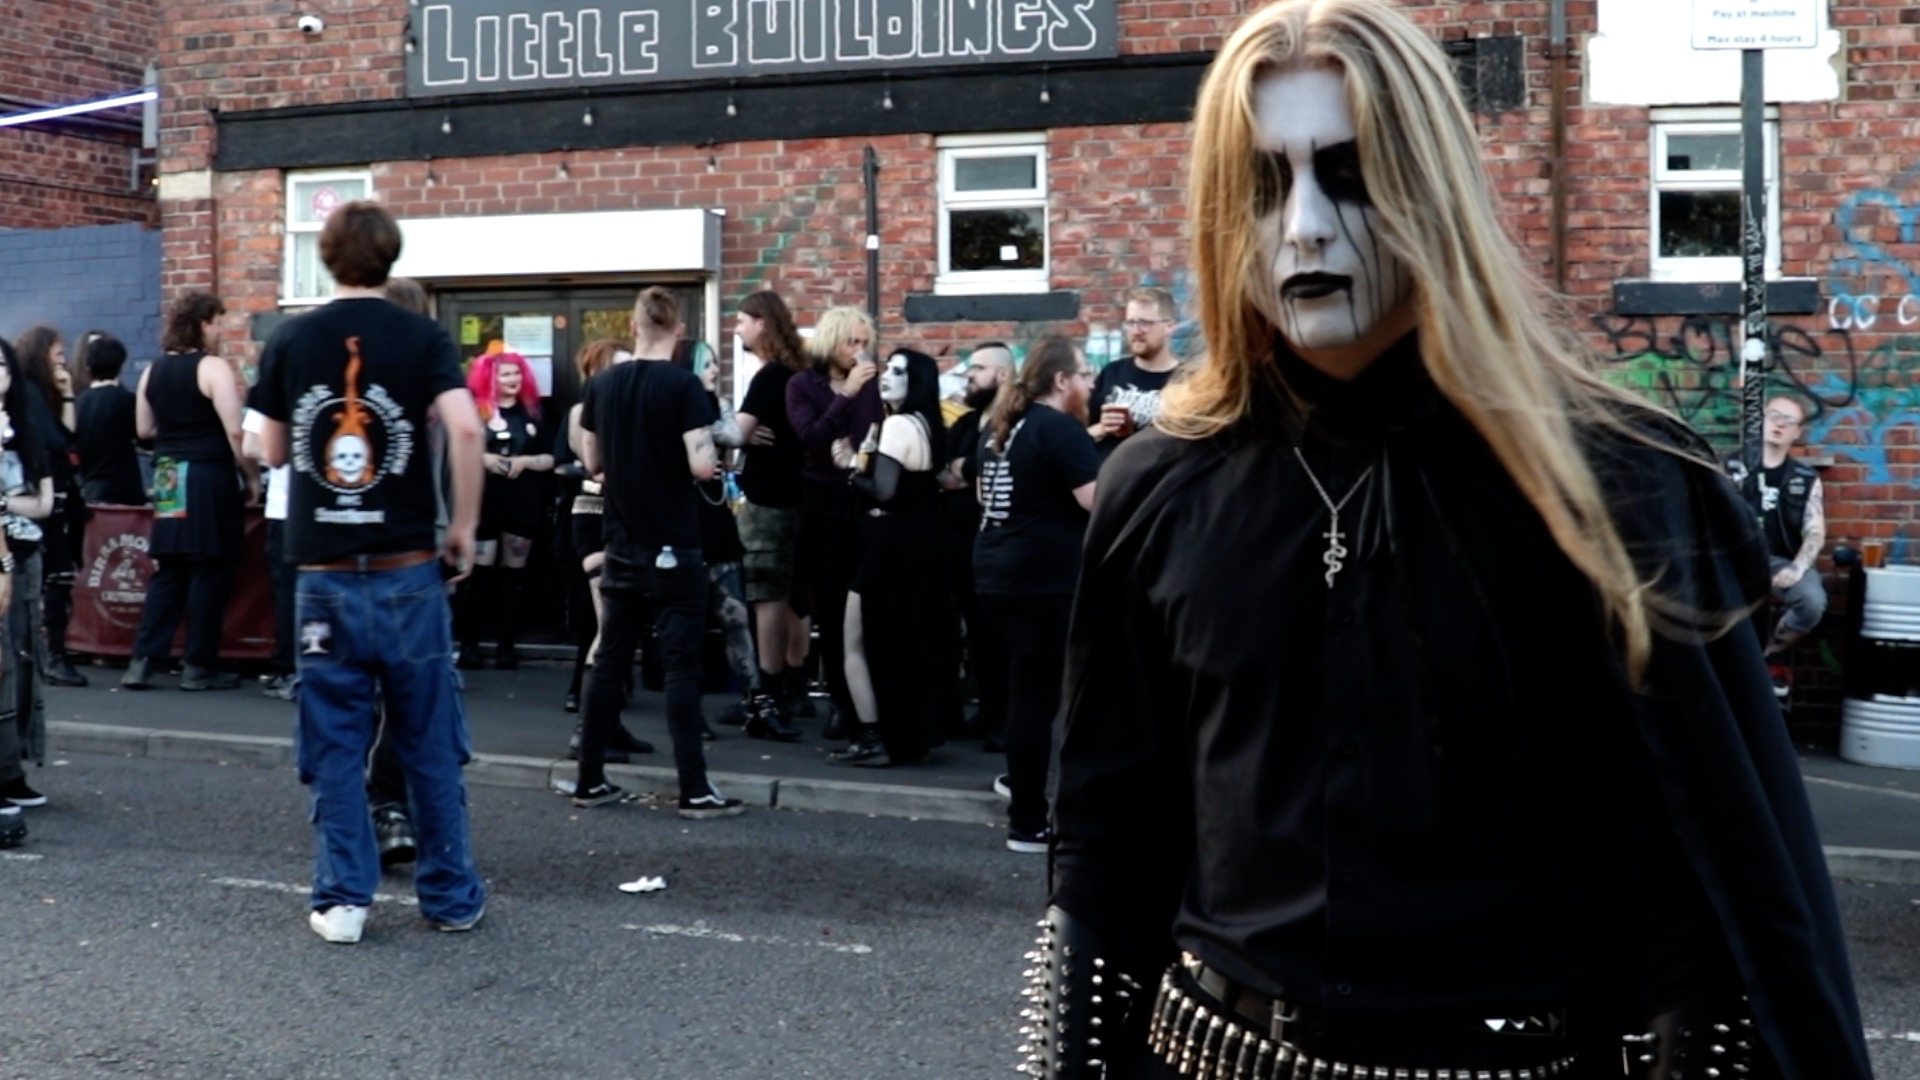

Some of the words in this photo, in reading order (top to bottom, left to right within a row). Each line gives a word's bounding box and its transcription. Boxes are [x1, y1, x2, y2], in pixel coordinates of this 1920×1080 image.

[1712, 9, 1733, 19] Pay
[1736, 9, 1746, 18] at
[1750, 8, 1796, 18] machine
[692, 0, 1097, 68] BUILDINGS
[1707, 34, 1730, 44] Max
[1733, 35, 1756, 44] stay
[1760, 34, 1767, 42] 4
[1770, 34, 1802, 43] hours
